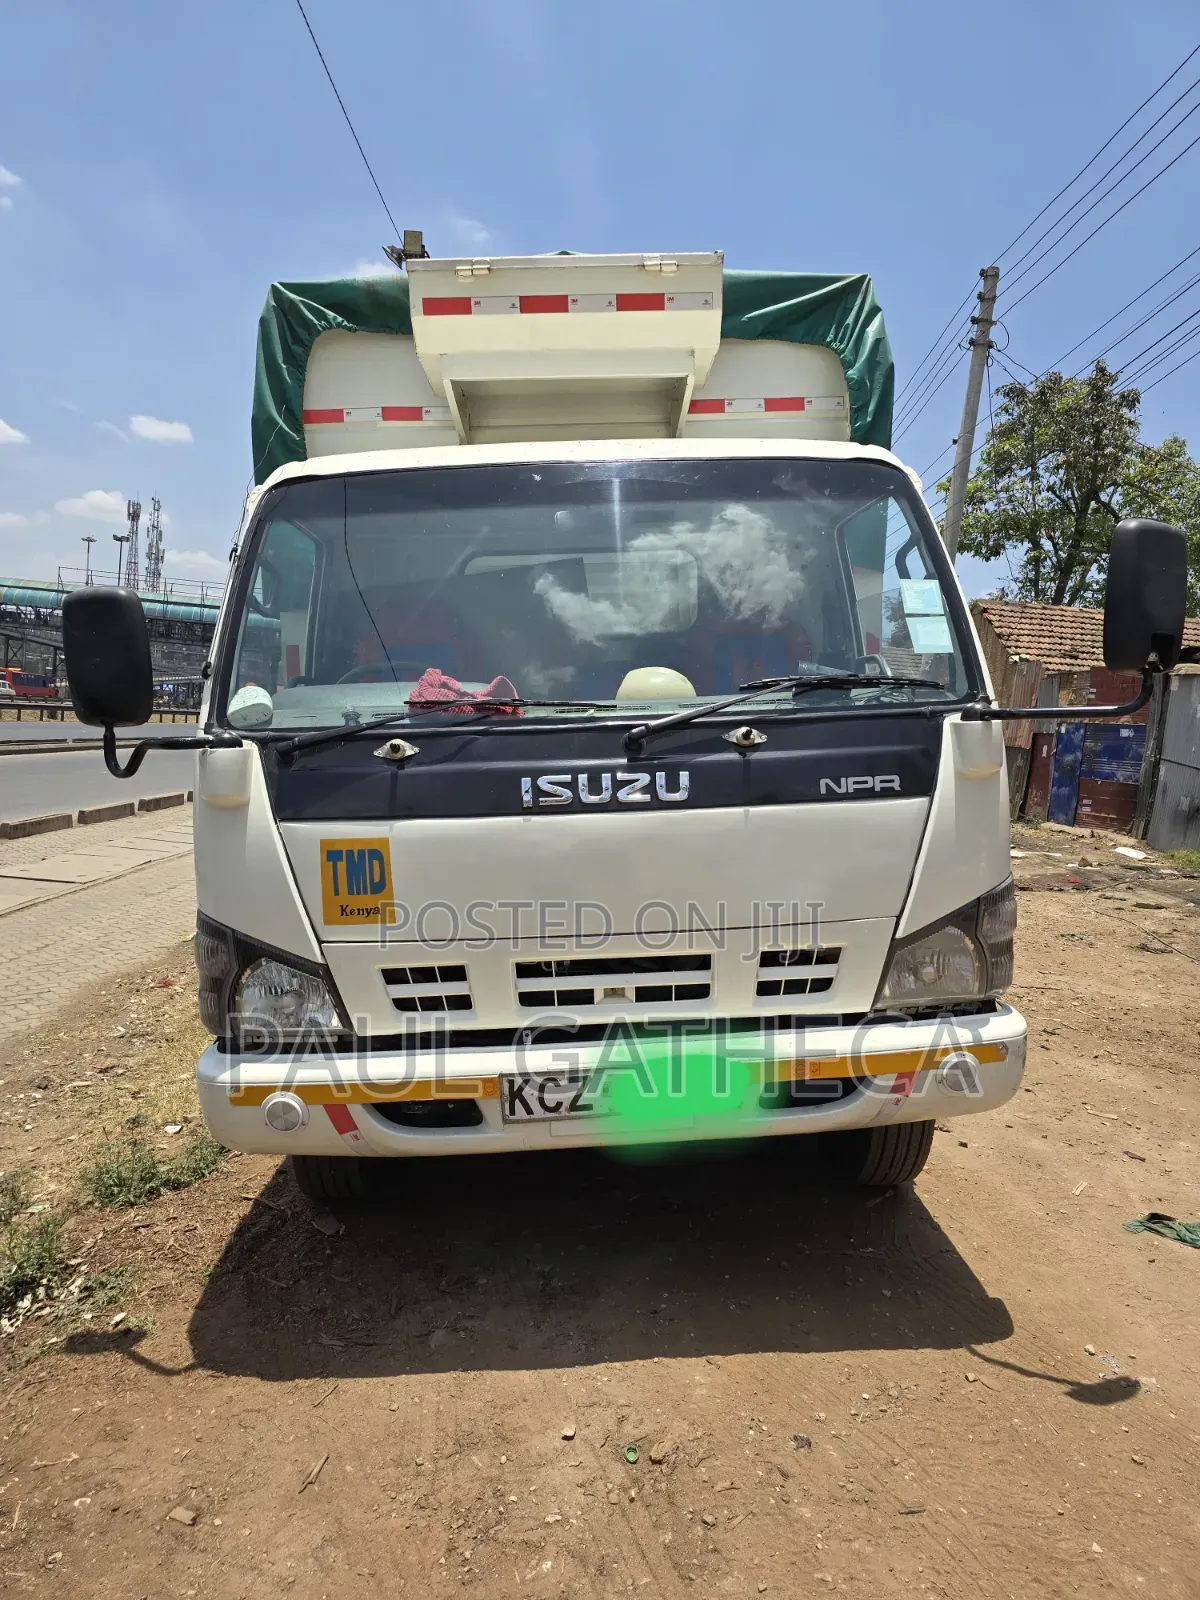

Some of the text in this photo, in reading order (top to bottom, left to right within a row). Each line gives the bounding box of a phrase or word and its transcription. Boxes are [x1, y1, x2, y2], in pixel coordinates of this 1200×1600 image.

[521, 772, 690, 808] ISUZU
[819, 774, 901, 795] NPR
[326, 848, 387, 897] TMD
[339, 904, 381, 918] Kenya
